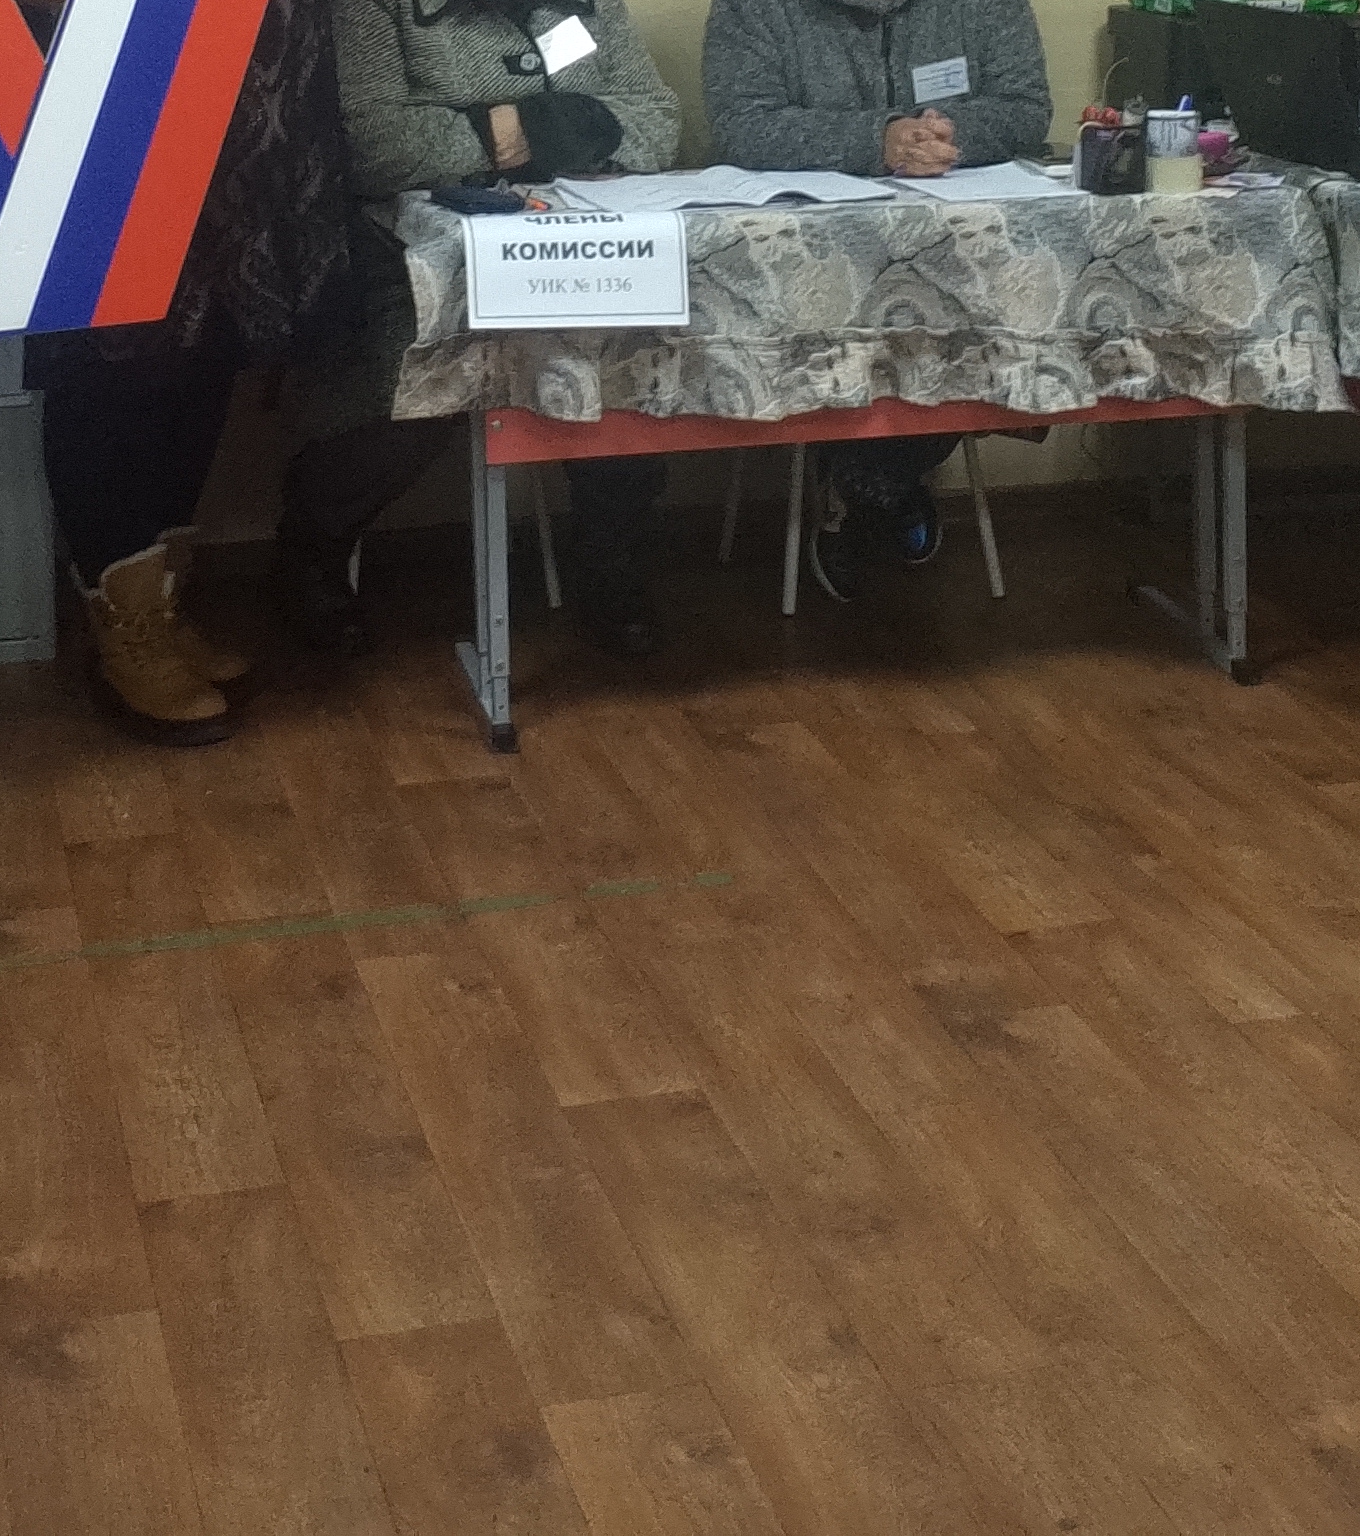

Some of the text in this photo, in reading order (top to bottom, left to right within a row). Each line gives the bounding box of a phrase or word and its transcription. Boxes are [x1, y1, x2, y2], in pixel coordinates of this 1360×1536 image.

[502, 239, 654, 261] КОМИССИИ
[528, 276, 632, 295] УИК № 1336
